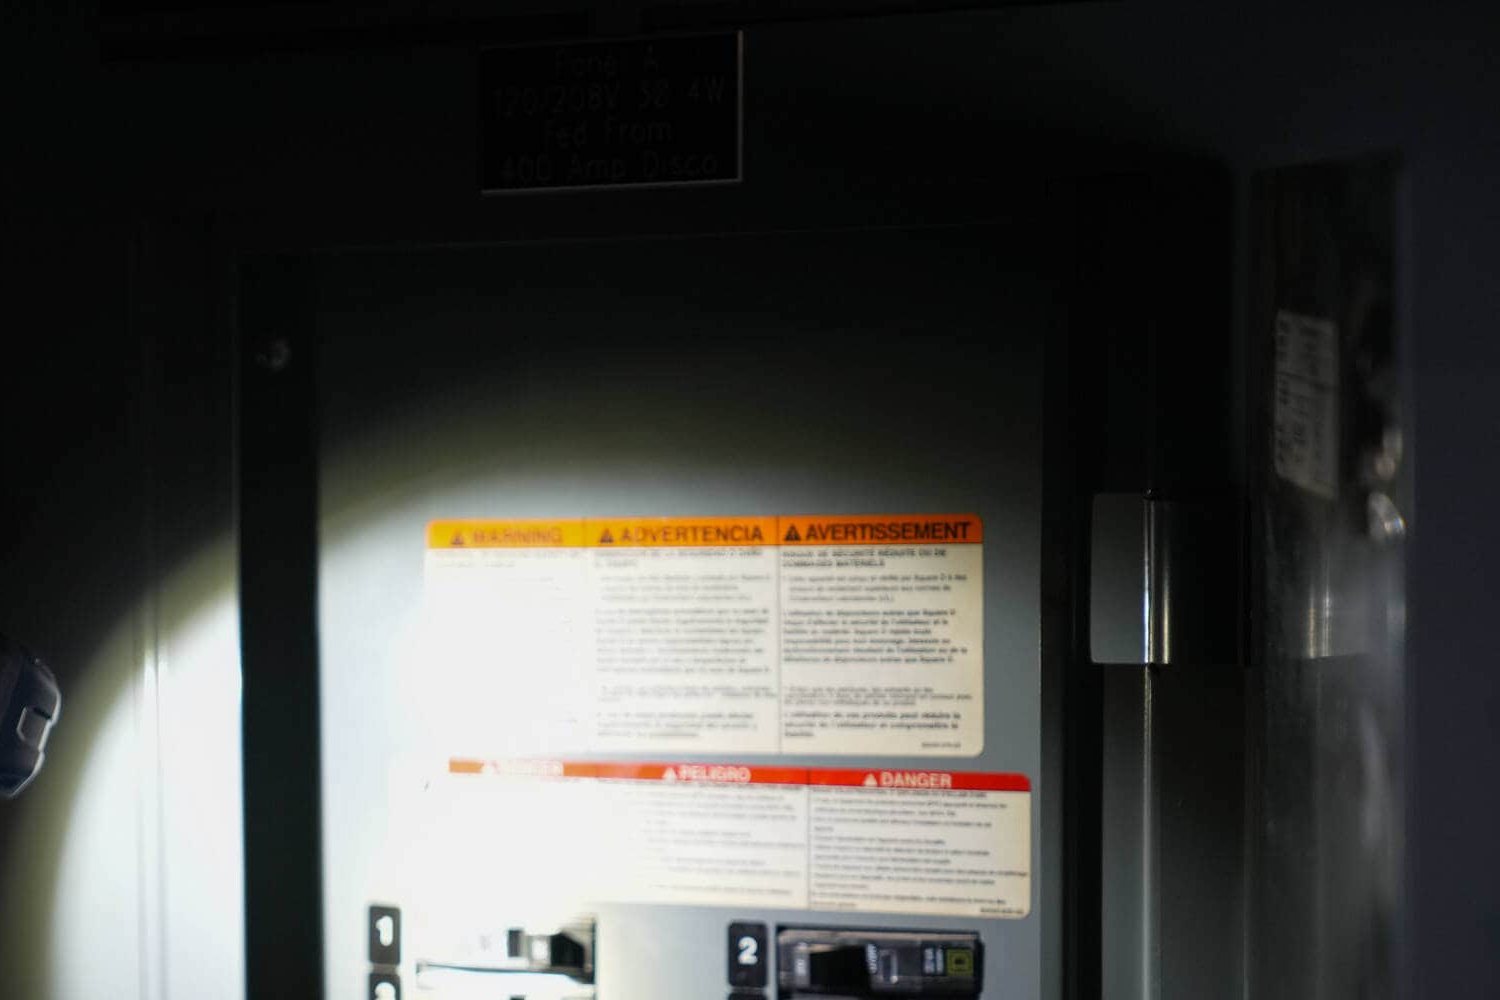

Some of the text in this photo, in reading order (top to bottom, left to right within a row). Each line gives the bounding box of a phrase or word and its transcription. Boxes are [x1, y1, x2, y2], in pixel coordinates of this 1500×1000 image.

[685, 73, 725, 105] 4W
[543, 112, 675, 152] Fed From
[500, 152, 553, 188] 400
[619, 525, 765, 543] ADVERTENCIA
[805, 521, 971, 542] AVERTISSEMENT
[680, 766, 753, 784] PELIGRO
[881, 771, 953, 789] DANGER
[376, 915, 394, 946] 1
[738, 936, 758, 965] 2
